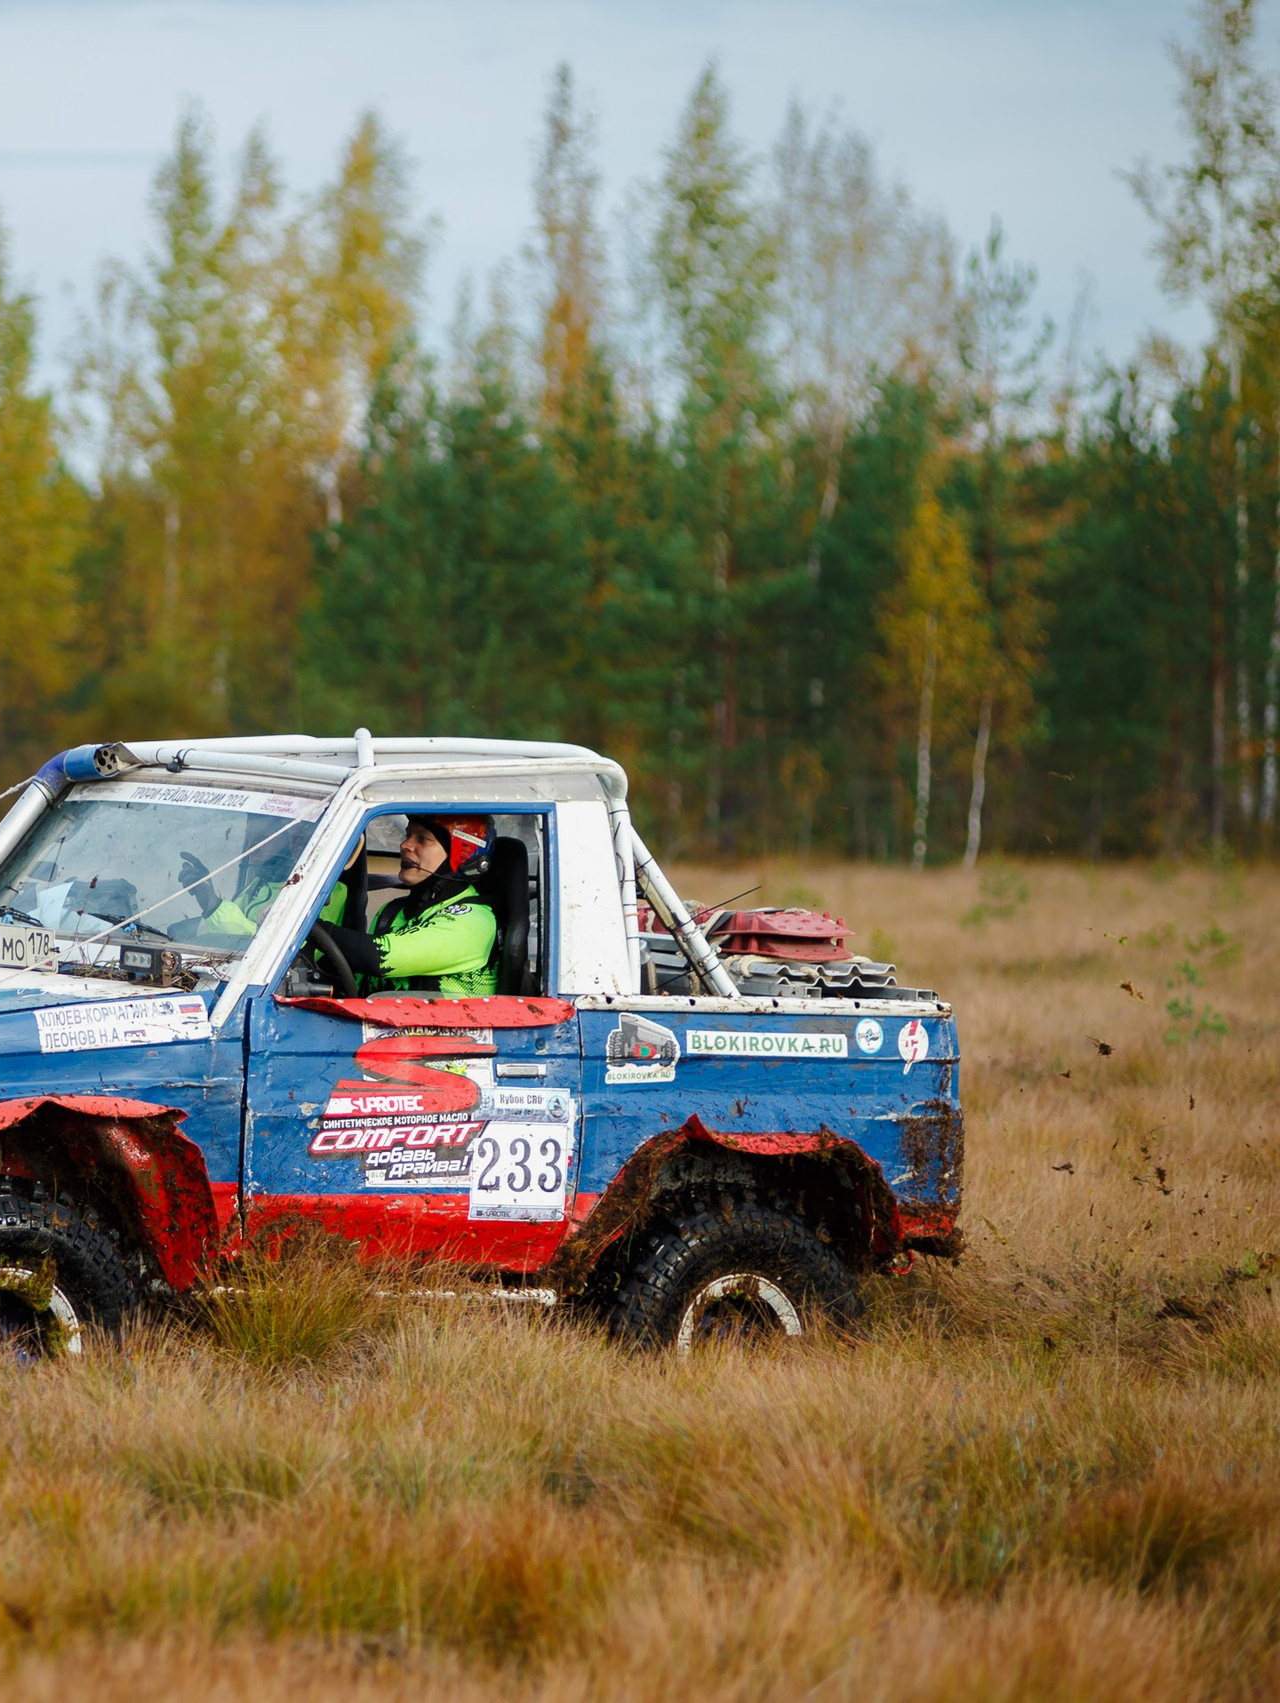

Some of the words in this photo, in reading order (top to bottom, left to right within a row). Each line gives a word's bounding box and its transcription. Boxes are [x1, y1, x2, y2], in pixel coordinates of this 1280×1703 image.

[130, 786, 193, 802] ТРОФИ-РЕЙДЫ
[28, 932, 50, 956] 178
[40, 1002, 148, 1028] КЛЮЕВ-КОРЧАГИН
[45, 1029, 96, 1049] ЛЕОНОВ
[691, 1034, 843, 1053] BLOKIROVKA.RU
[607, 1072, 671, 1080] BLOKIROVKA.RU
[352, 1095, 424, 1113] SUPROTEC
[500, 1094, 524, 1104] Кубок
[323, 1117, 392, 1129] СИНТЕТИЧЕСКОЕ
[394, 1115, 438, 1125] МОТОРНОЕ
[439, 1113, 468, 1122] МАСЛО
[311, 1122, 481, 1151] COMFORT
[477, 1137, 562, 1192] 233
